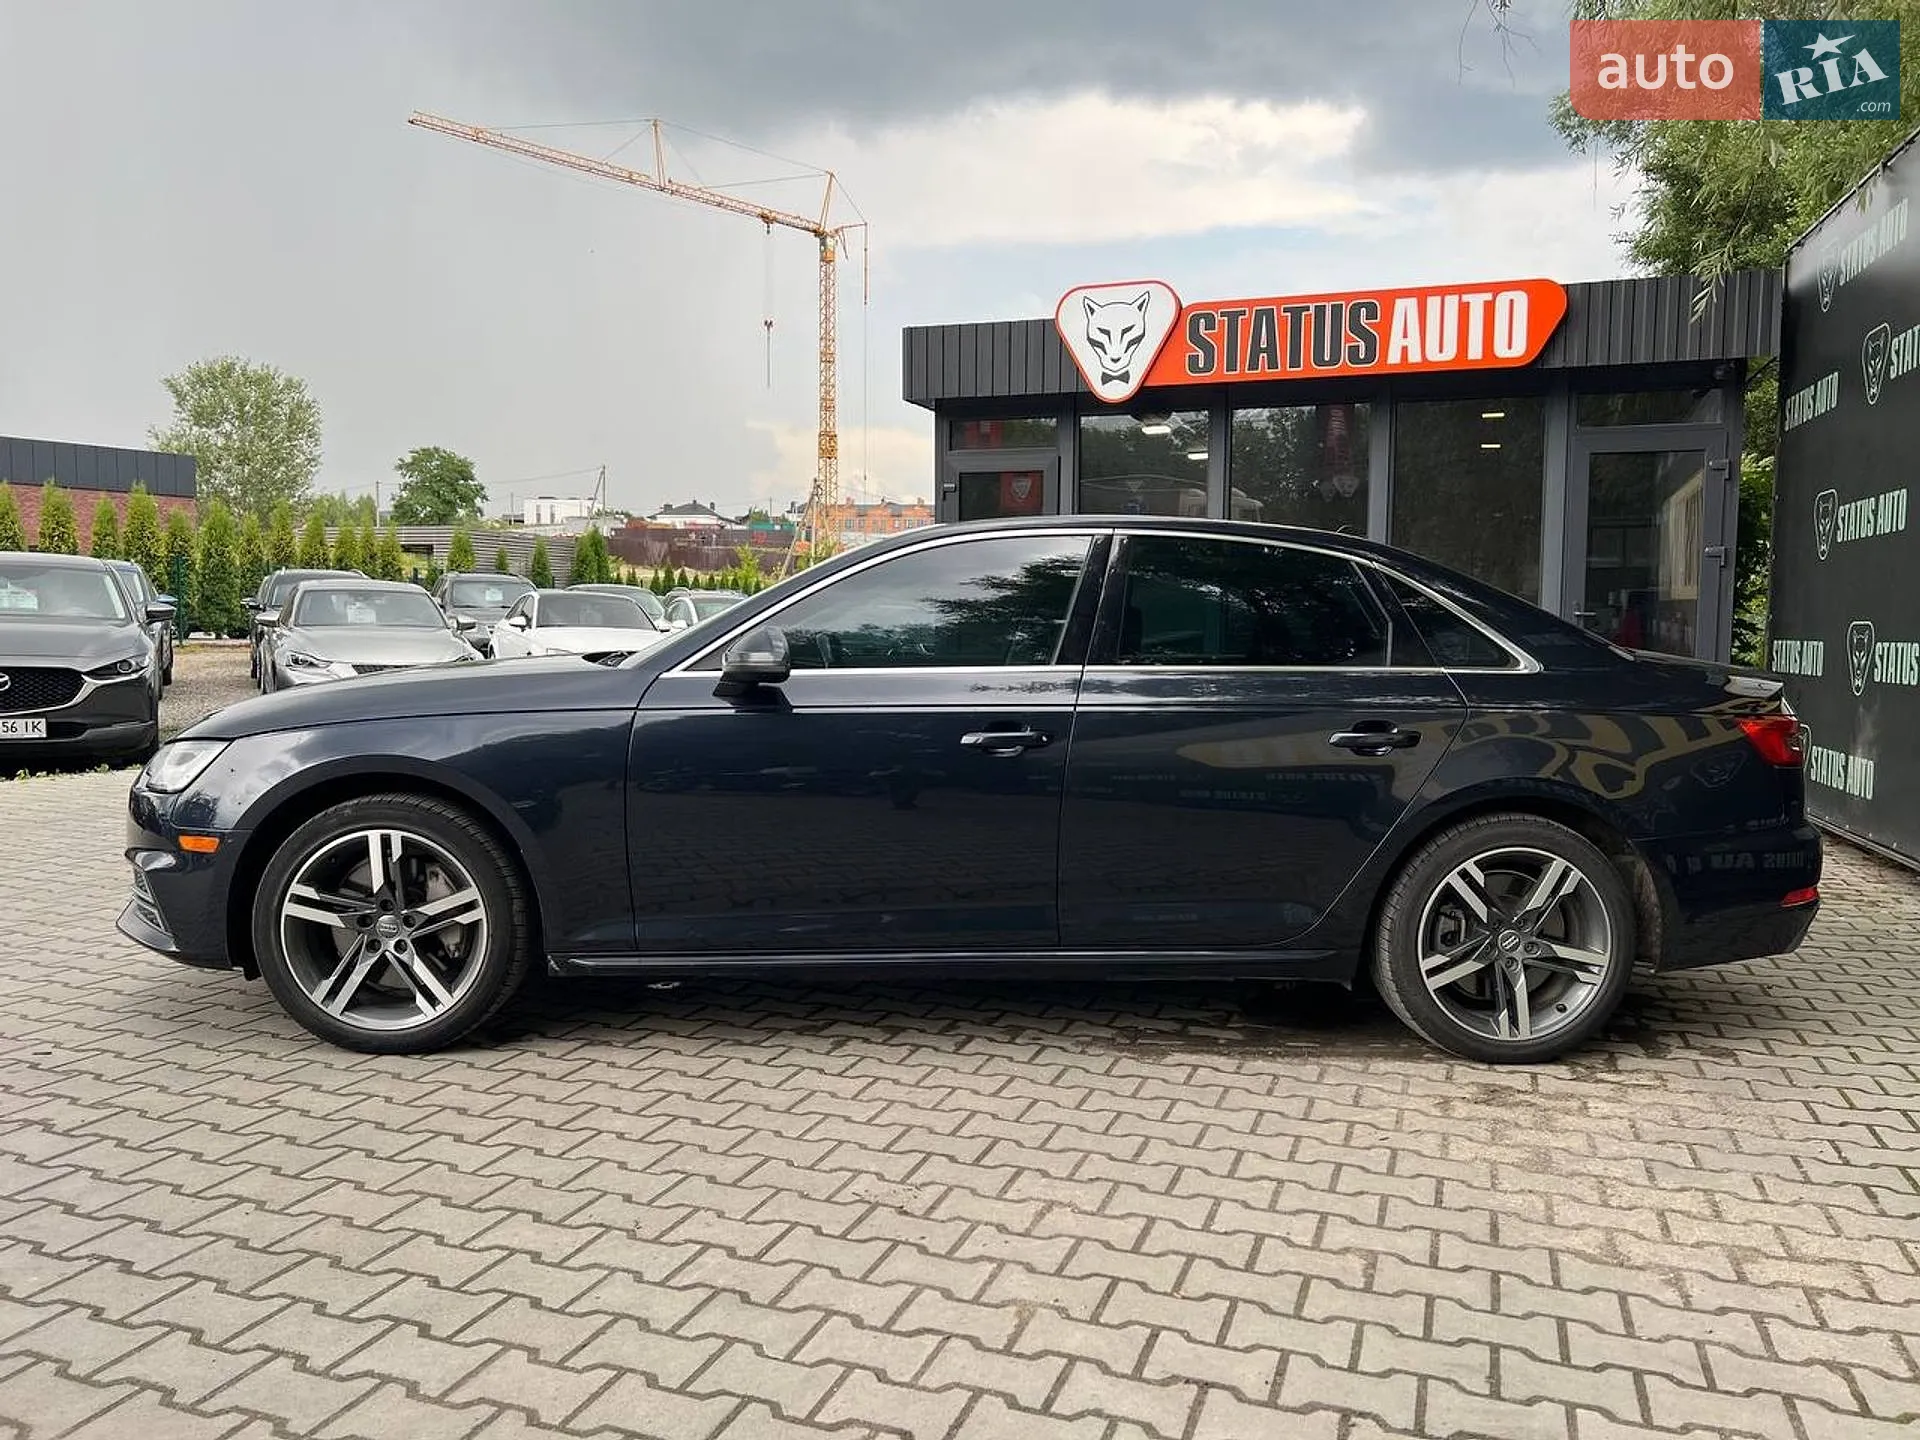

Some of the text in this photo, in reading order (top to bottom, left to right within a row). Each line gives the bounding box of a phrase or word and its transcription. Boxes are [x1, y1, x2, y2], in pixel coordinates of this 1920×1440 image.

[1184, 290, 1530, 377] STATUS AUTO
[1890, 324, 1920, 380] STAT
[1784, 371, 1839, 431] STATUS AUTO
[1837, 488, 1907, 543] STATUS AUTO
[1771, 640, 1824, 677] STATUS AUTO
[1873, 641, 1920, 686] STATUS
[25, 720, 42, 733] IK
[1810, 745, 1874, 800] STATUS AUTO
